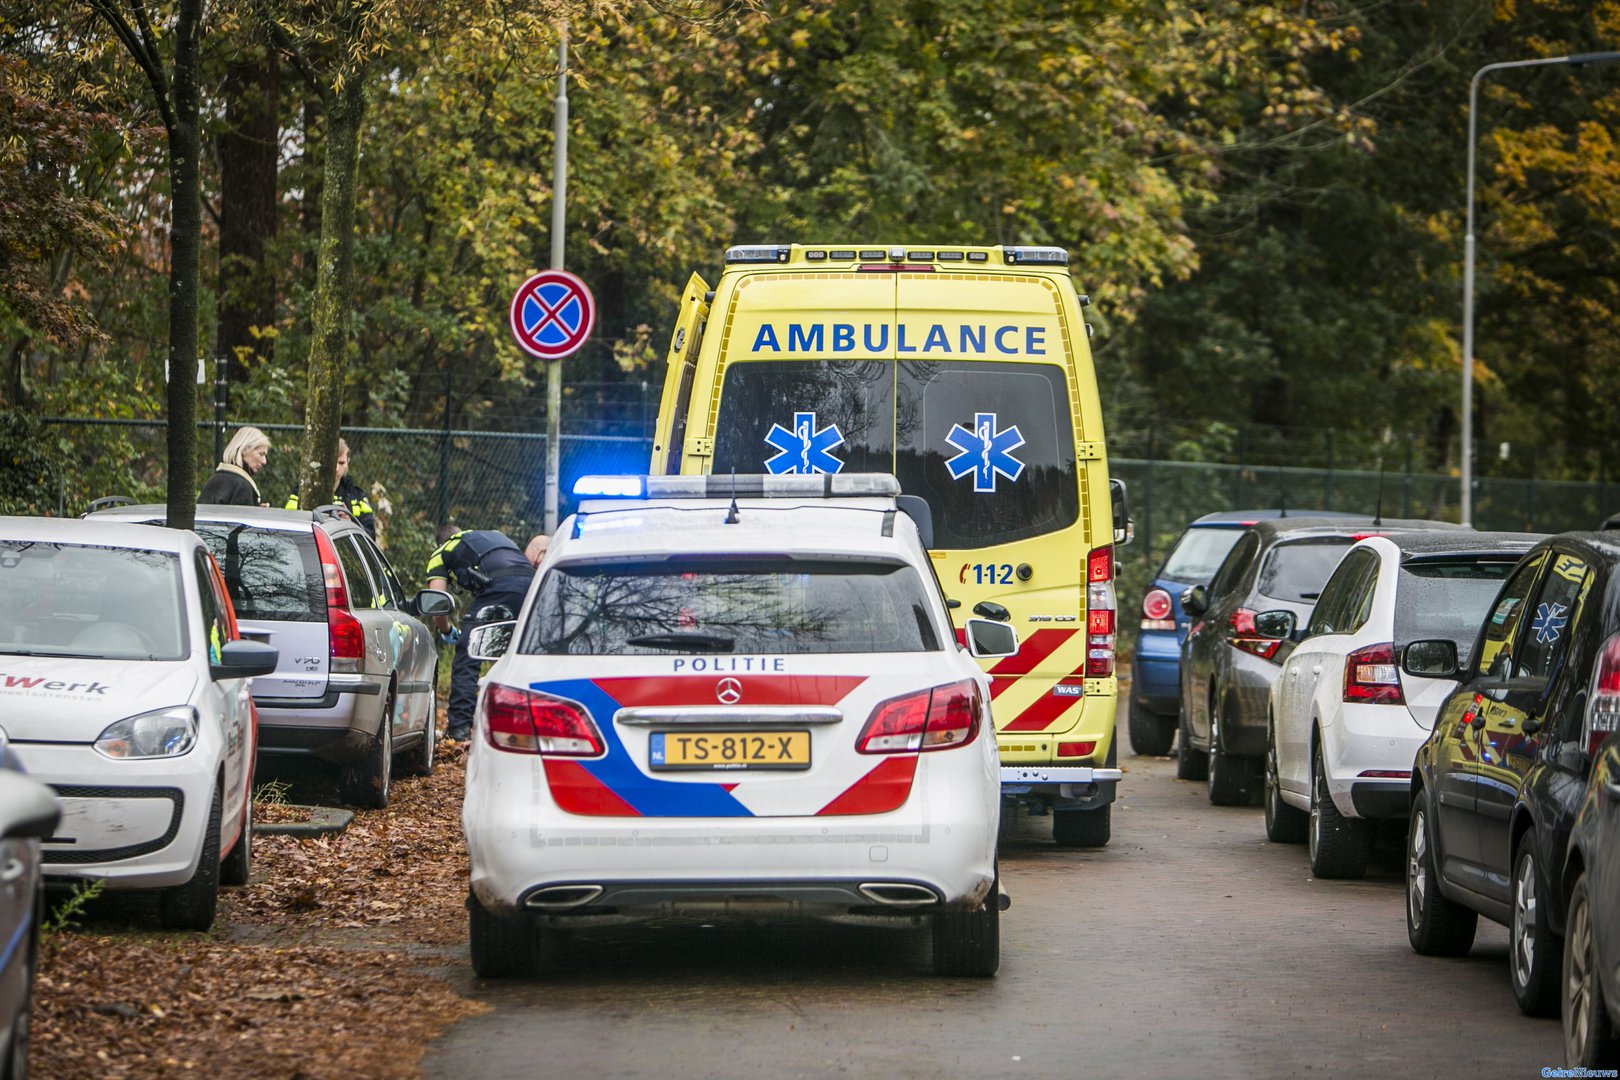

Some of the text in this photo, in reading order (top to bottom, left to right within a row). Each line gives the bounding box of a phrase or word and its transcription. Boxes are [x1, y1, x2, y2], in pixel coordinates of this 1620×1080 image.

[751, 323, 1046, 355] AMBULANCE
[973, 563, 1013, 584] 1-1-2
[294, 655, 320, 665] V70
[673, 657, 785, 672] POLITIE
[1056, 686, 1080, 695] WAS
[652, 737, 793, 761] NL TS-812-X
